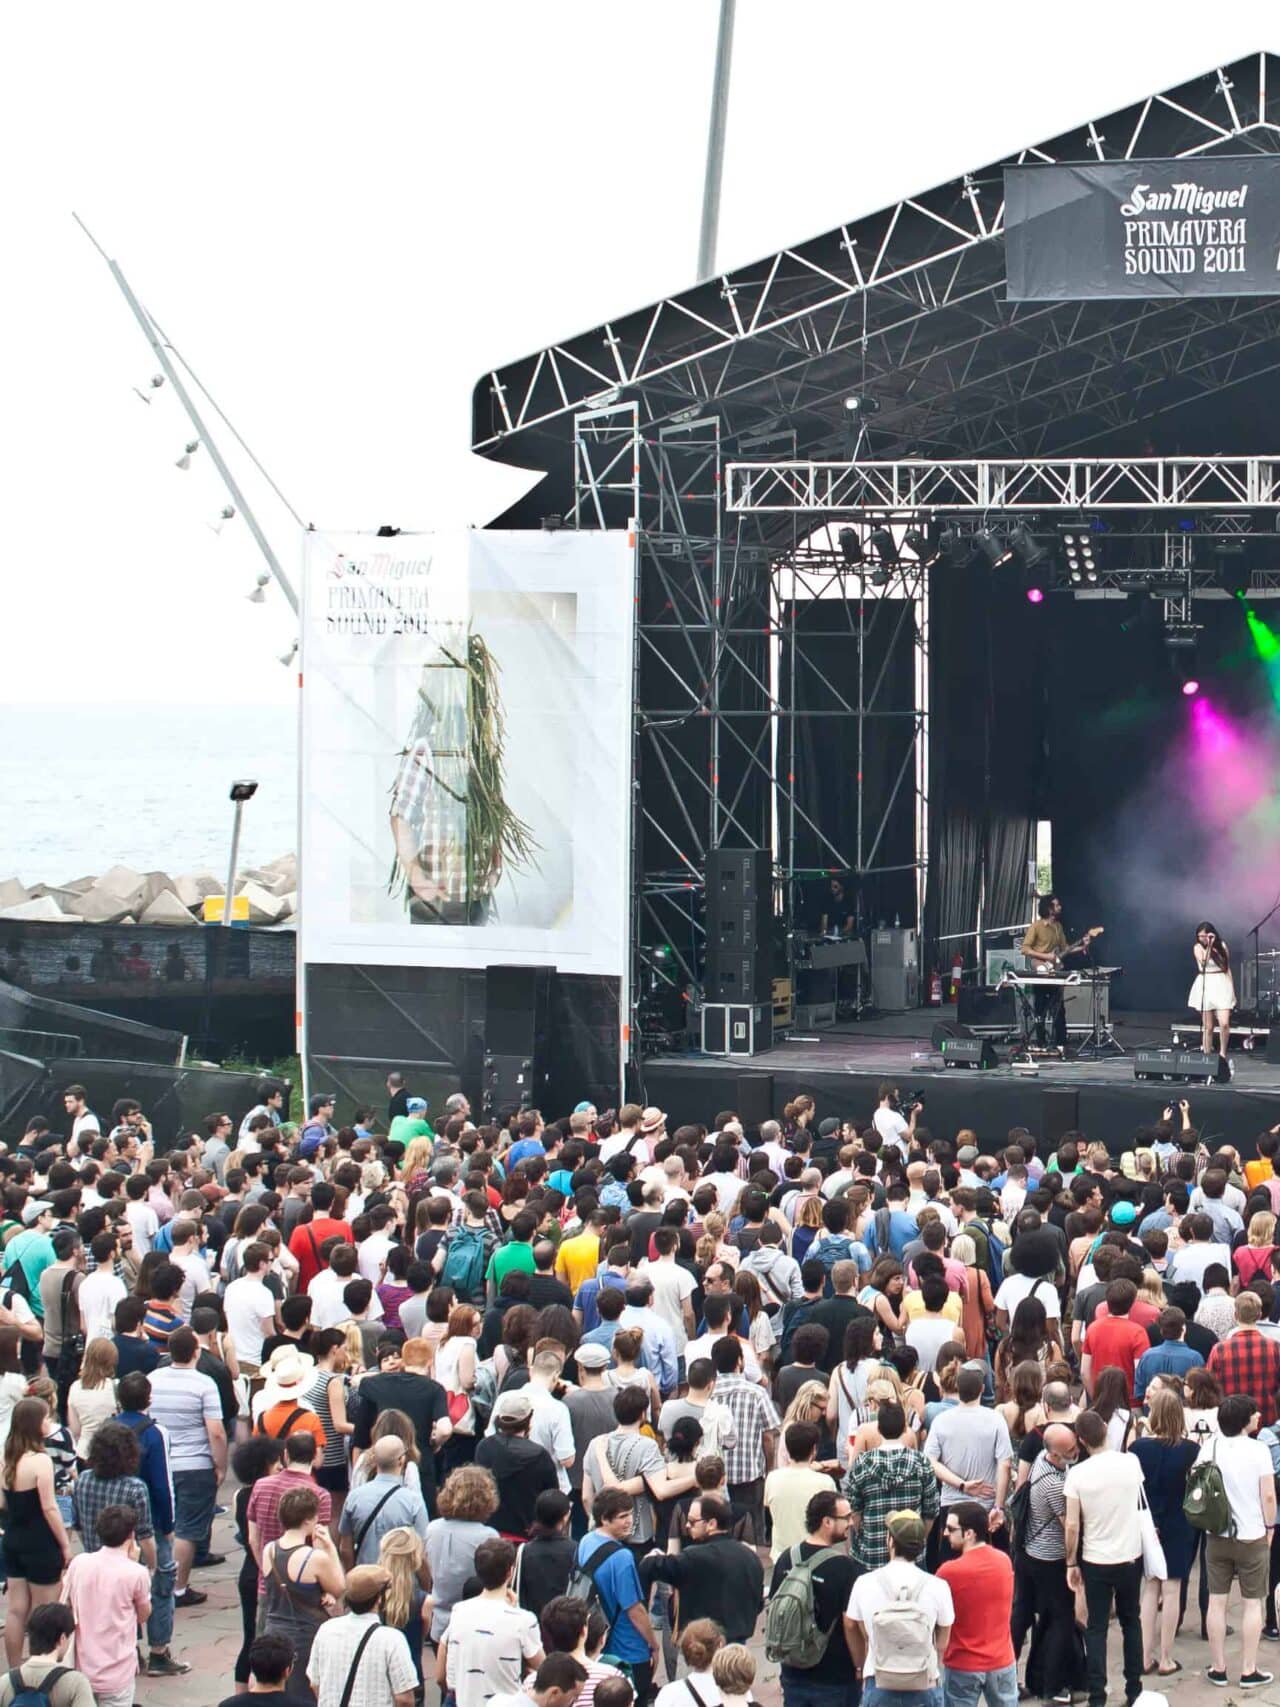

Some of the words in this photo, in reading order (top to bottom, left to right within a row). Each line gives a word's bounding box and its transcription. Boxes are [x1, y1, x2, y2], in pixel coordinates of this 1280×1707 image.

[1124, 218, 1248, 248] PRIMAVERA
[1124, 248, 1196, 275] SOUND
[1203, 246, 1247, 273] 2011
